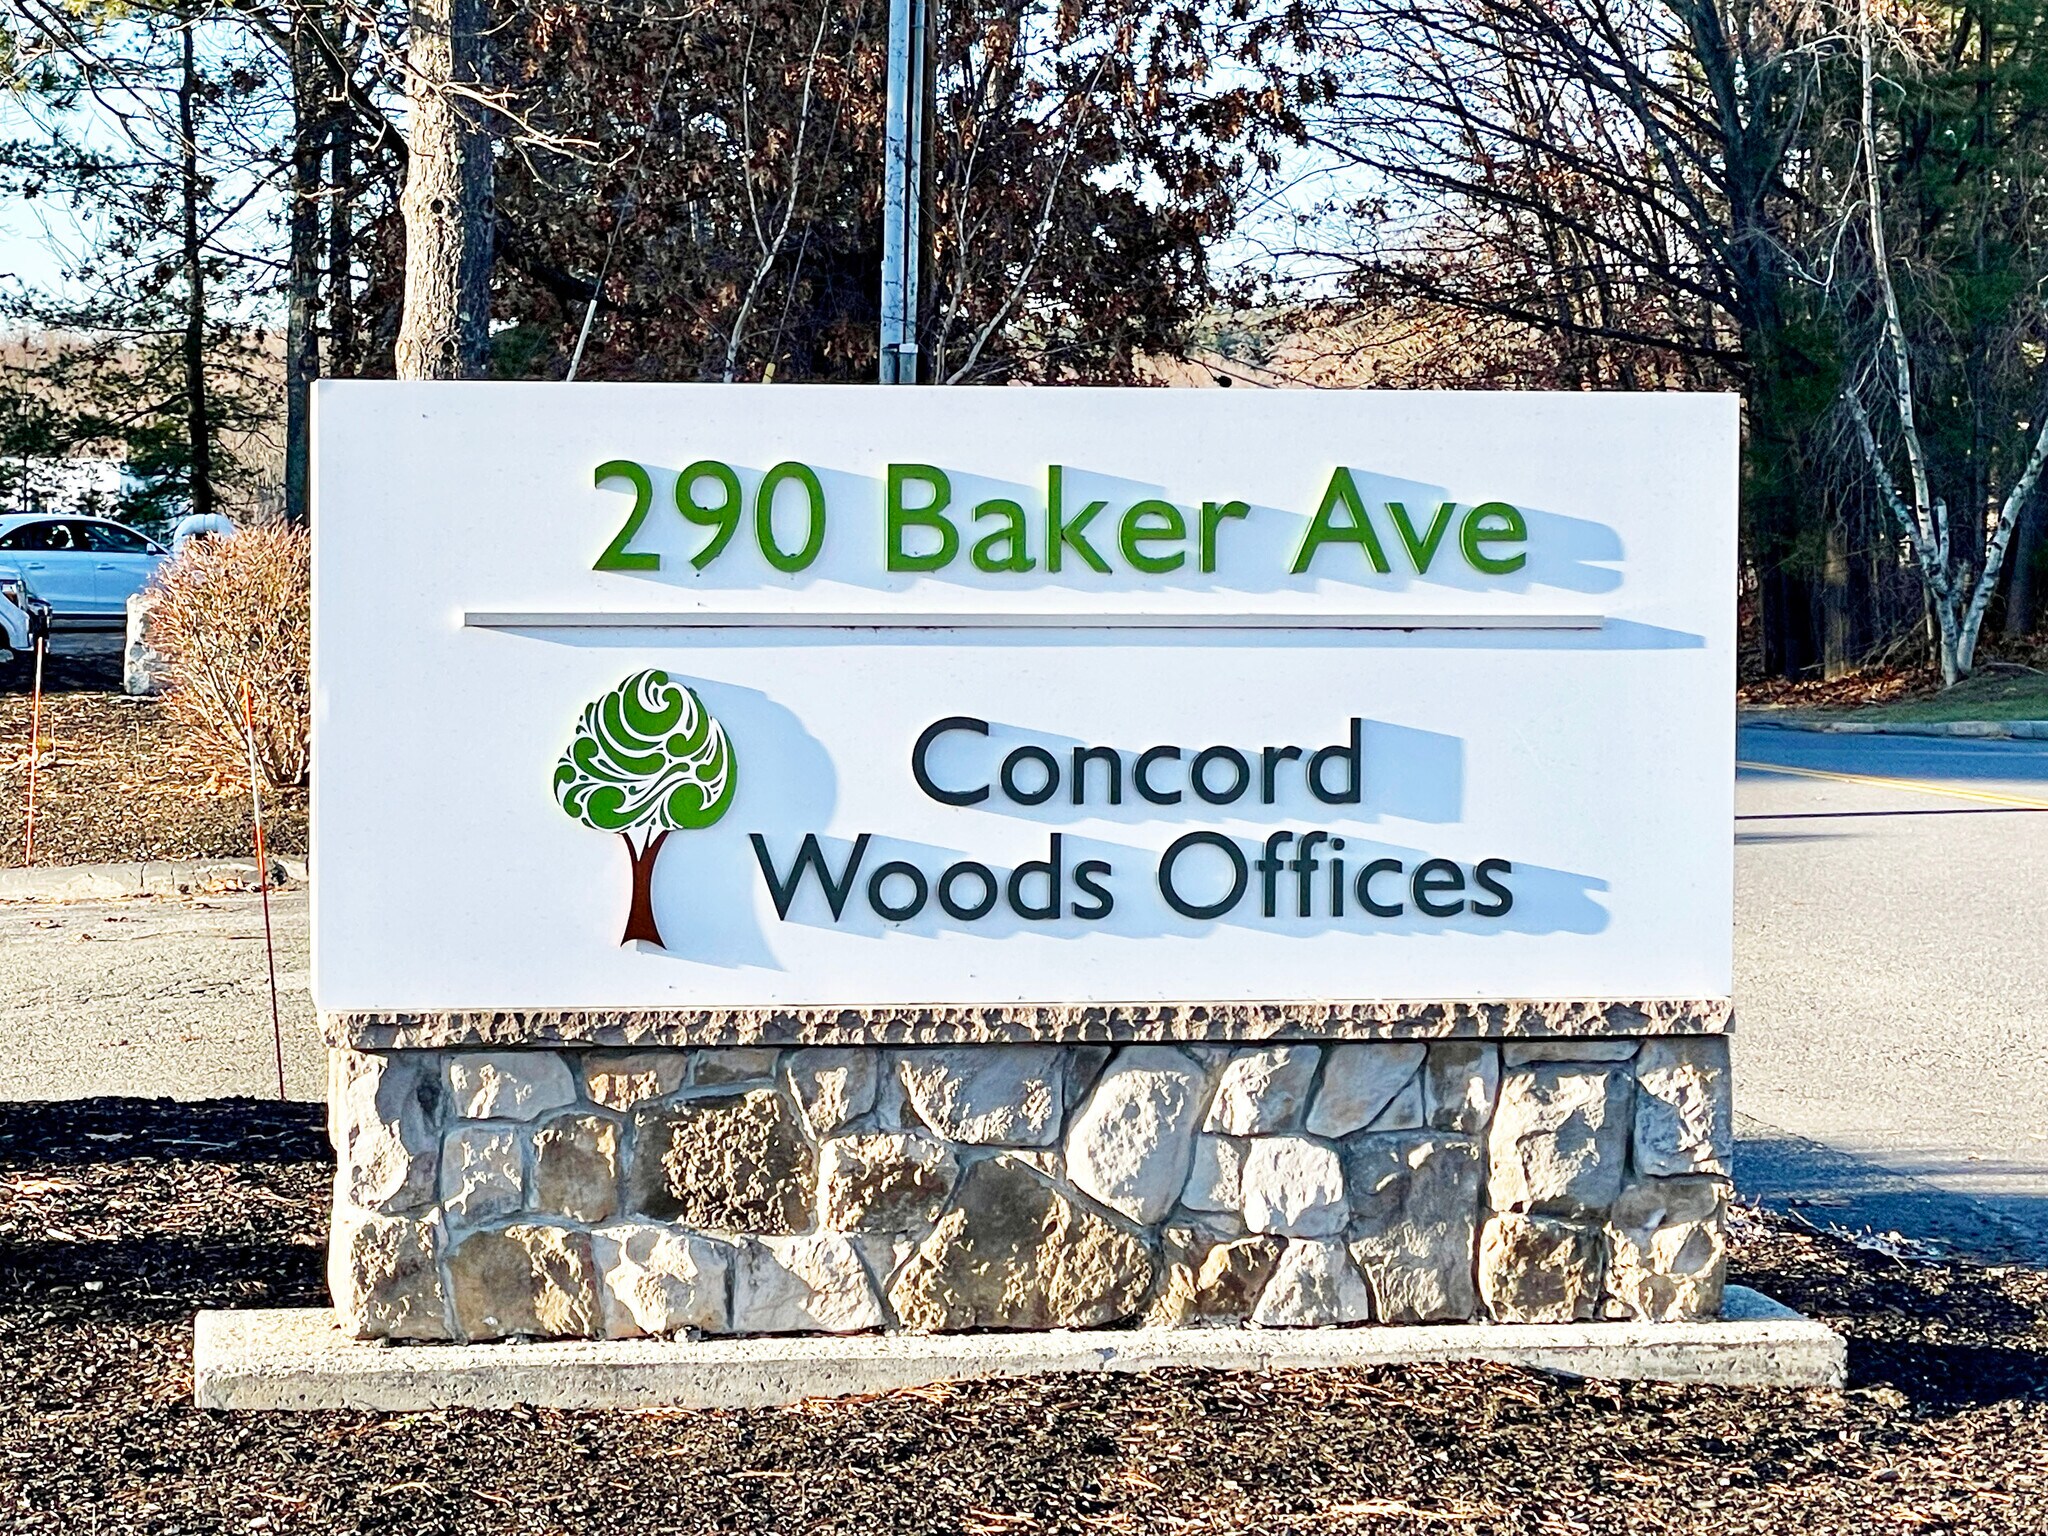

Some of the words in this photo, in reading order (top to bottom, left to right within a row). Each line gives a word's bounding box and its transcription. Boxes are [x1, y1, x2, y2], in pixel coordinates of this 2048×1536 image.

[592, 460, 826, 573] 290
[886, 463, 1251, 574] Baker
[1288, 466, 1527, 575] Ave
[912, 716, 1361, 806] Concord
[749, 832, 1114, 922] Woods
[1158, 830, 1513, 920] Offices
